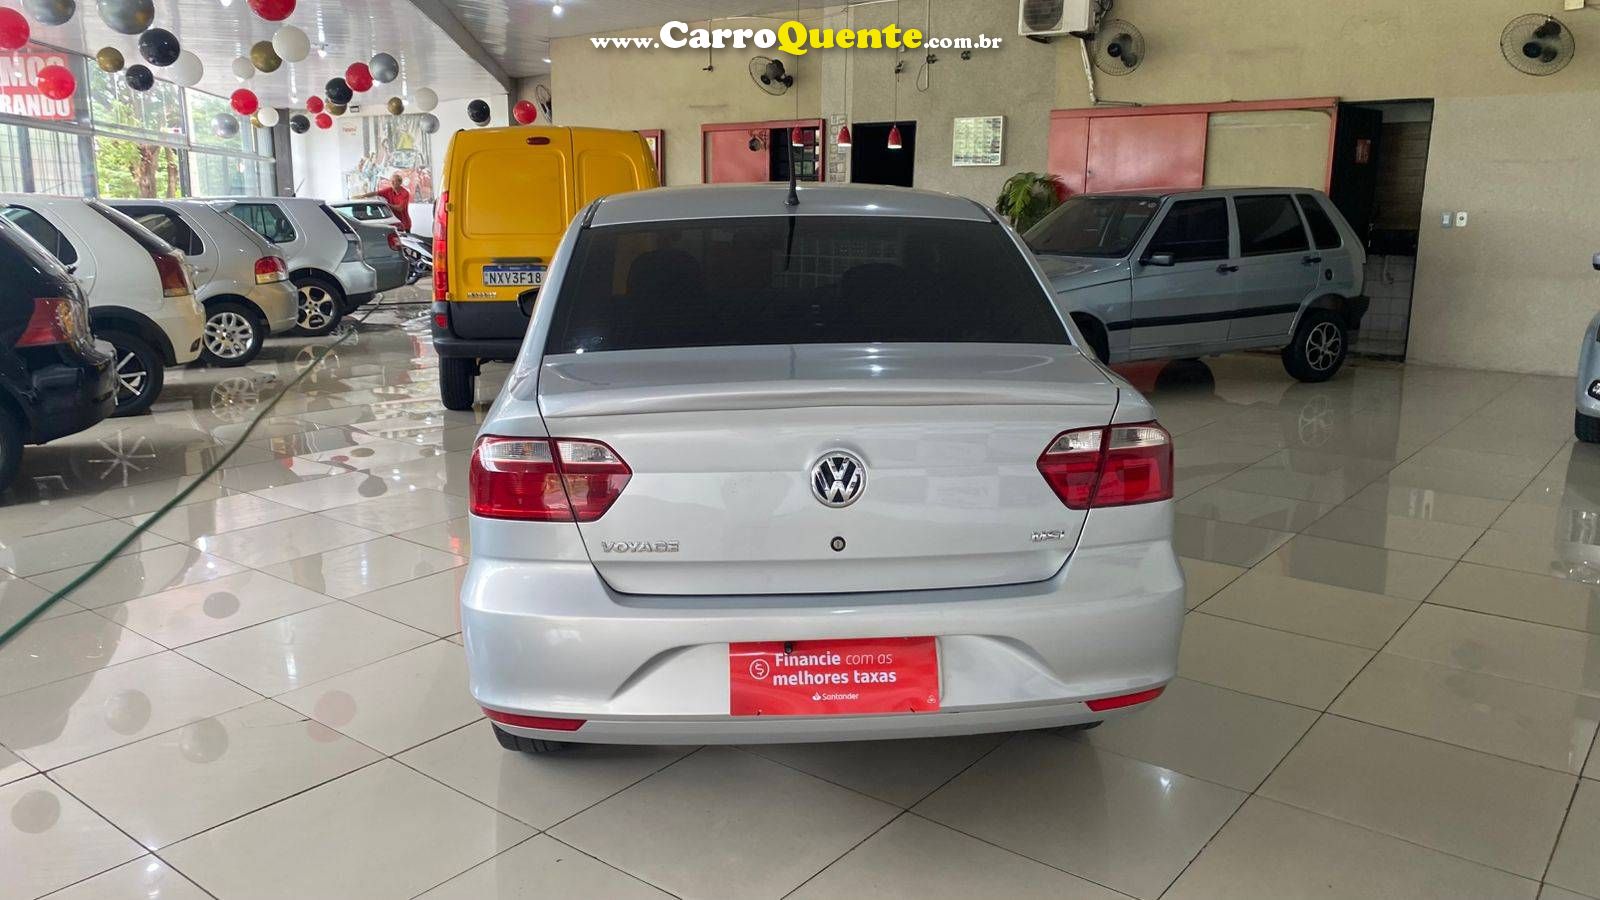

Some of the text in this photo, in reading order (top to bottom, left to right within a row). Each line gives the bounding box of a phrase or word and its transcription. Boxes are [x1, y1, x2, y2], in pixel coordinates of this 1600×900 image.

[489, 272, 542, 284] NXY3F18
[600, 539, 680, 553] VOYAGE
[775, 651, 893, 667] Financie com as
[773, 669, 897, 686] melhores taxas
[822, 692, 860, 701] Santander
